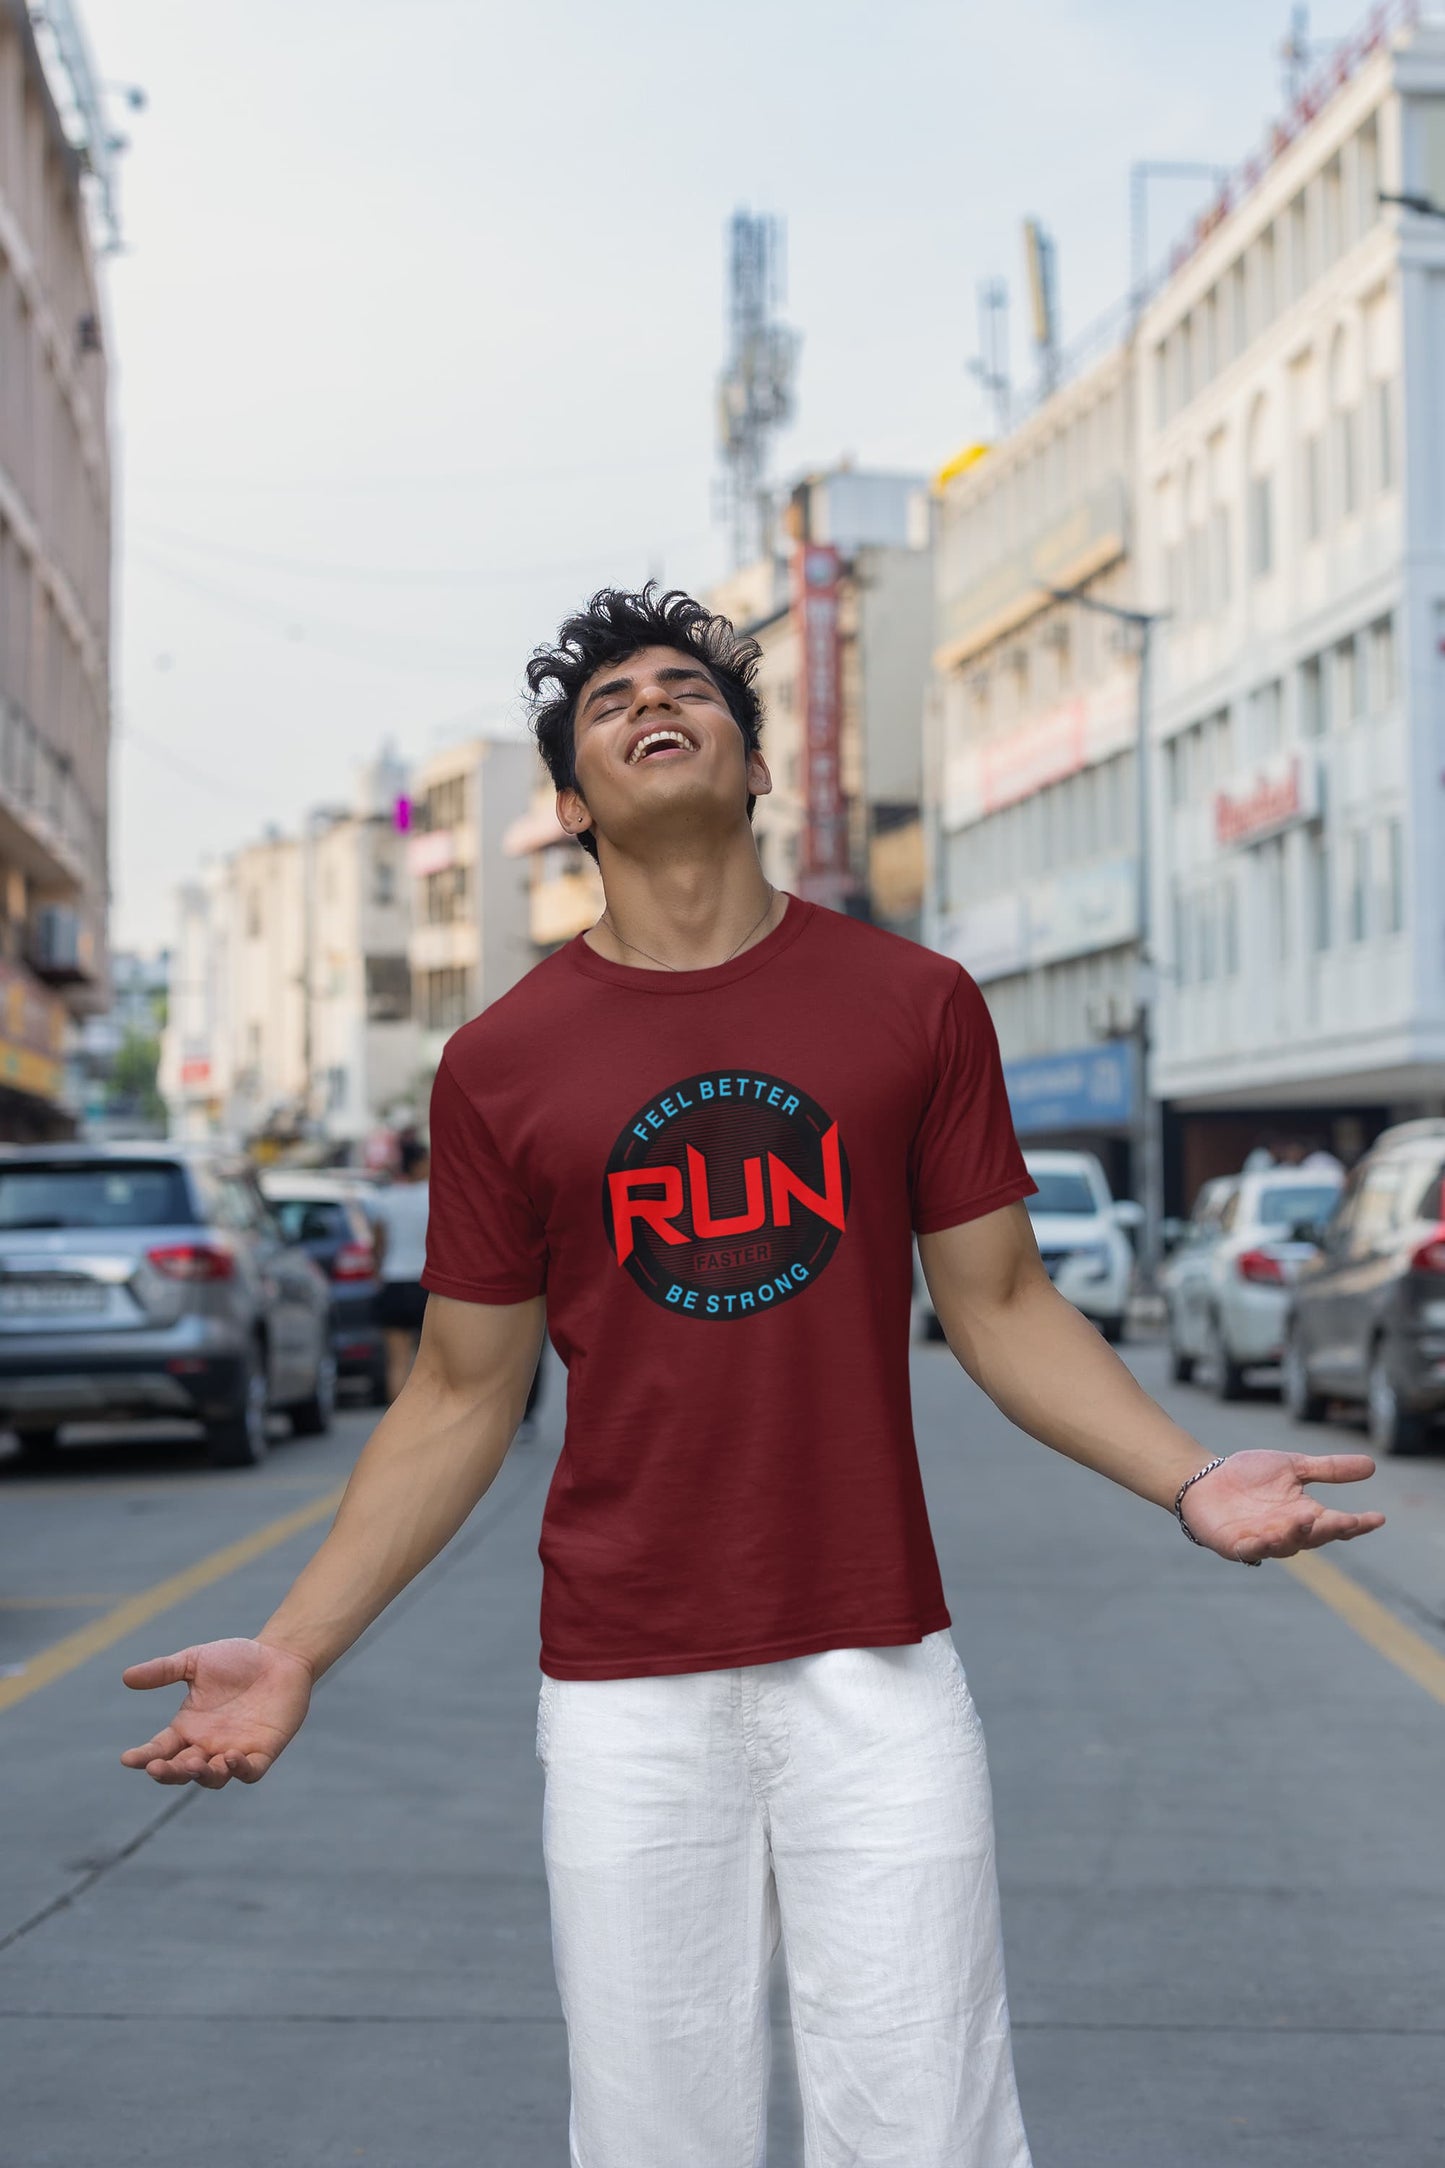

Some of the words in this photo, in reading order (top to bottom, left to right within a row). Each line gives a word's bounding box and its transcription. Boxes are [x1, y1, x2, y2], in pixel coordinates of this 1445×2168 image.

[633, 1091, 692, 1141] FEEL
[699, 1078, 800, 1115] BETTER
[607, 1119, 846, 1268] RUN
[696, 1245, 768, 1271] FASTER
[665, 1284, 699, 1310] BE
[705, 1263, 809, 1313] STRONG
